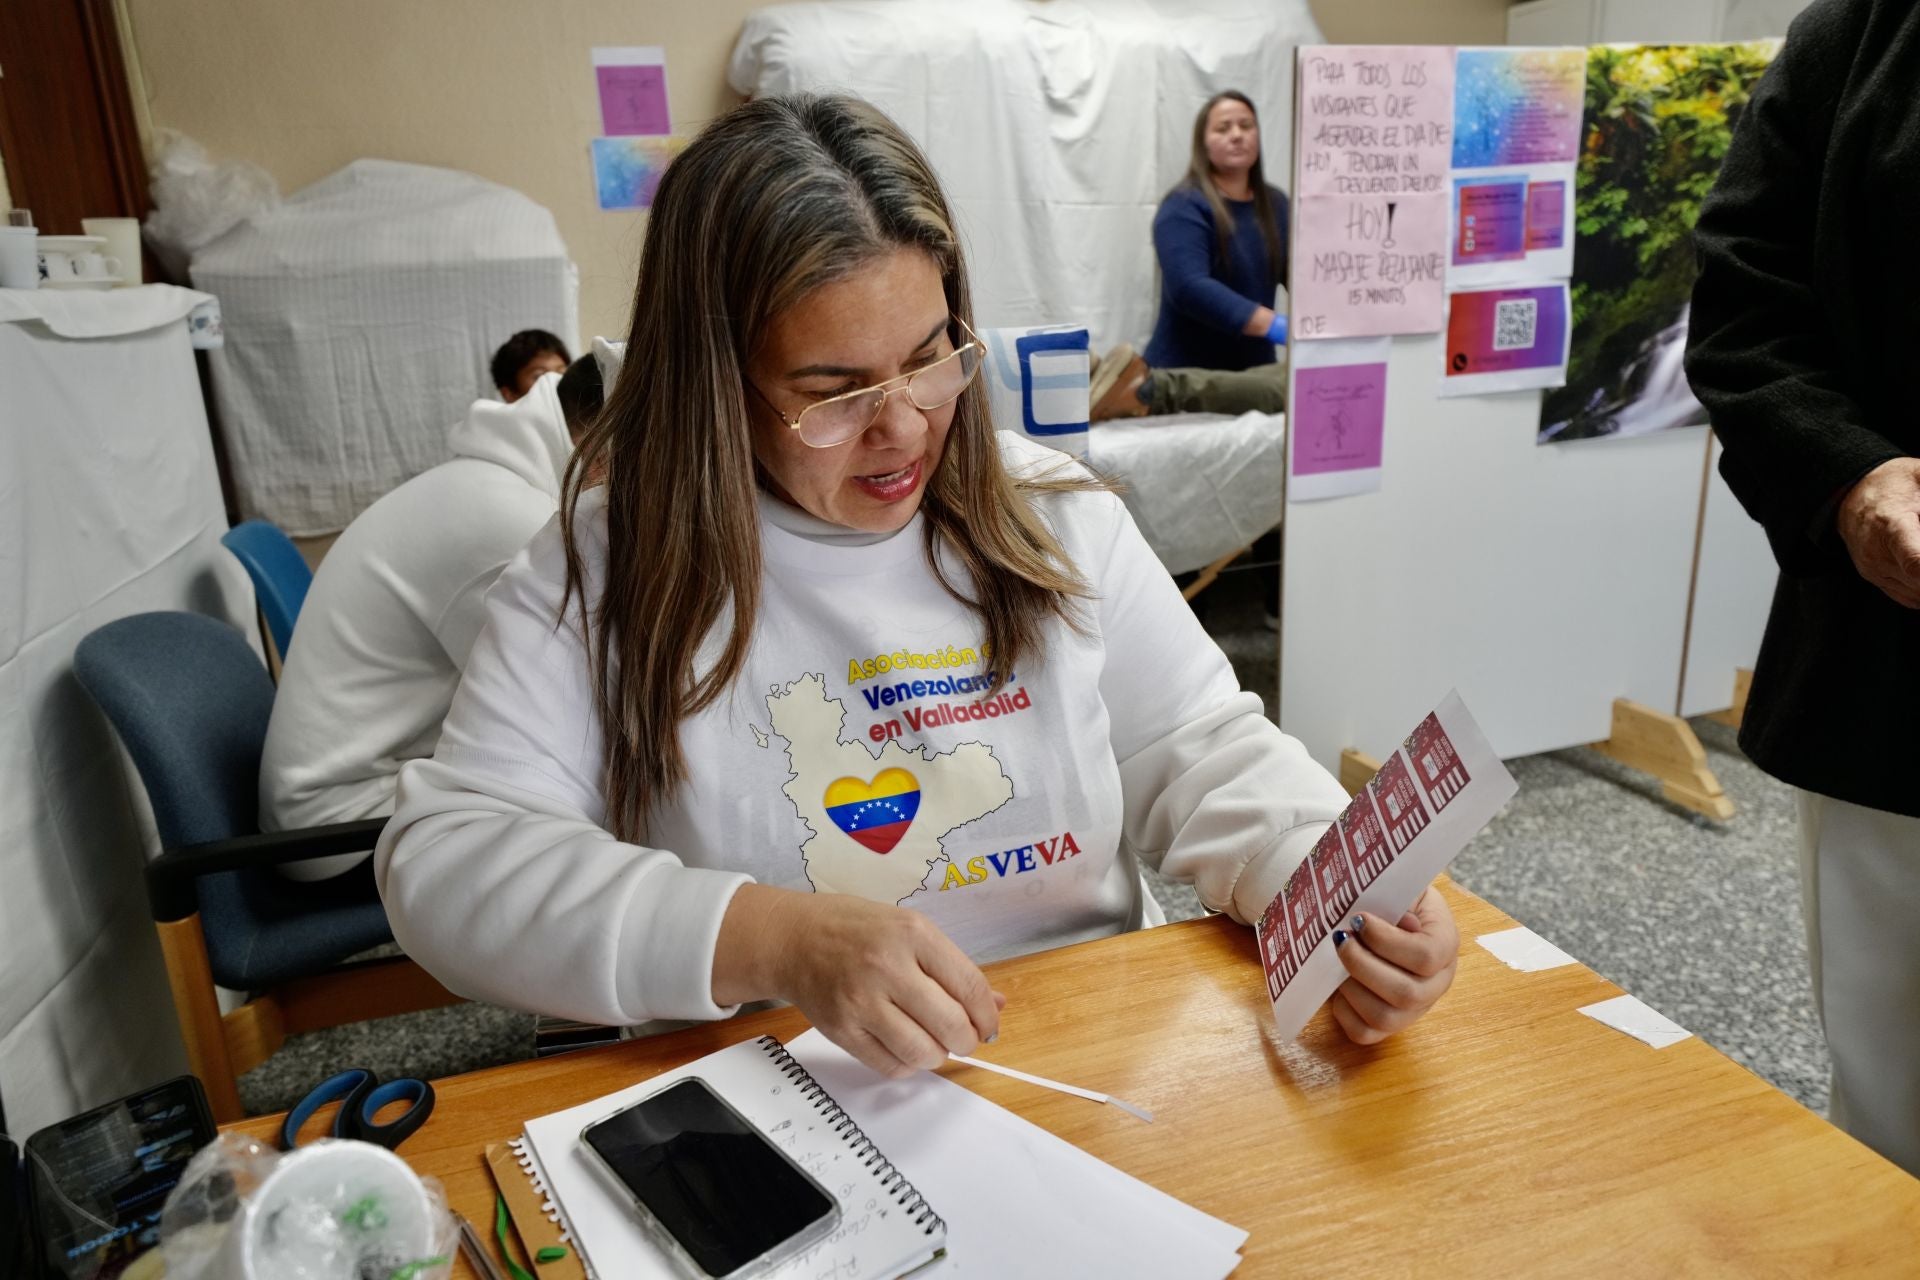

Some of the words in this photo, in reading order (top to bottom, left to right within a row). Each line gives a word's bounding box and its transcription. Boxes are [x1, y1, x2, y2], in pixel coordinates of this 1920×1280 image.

[1353, 61, 1391, 88] TODOS
[1402, 61, 1427, 87] LOS
[1385, 94, 1416, 119] QUE
[1383, 126, 1401, 148] EL
[1428, 121, 1451, 146] DE
[1345, 202, 1397, 248] HOY!
[1312, 251, 1373, 284] MASAJE
[1378, 250, 1446, 285] RELAJANTE
[1348, 289, 1362, 305] 15
[848, 645, 977, 685] Asociación
[869, 719, 903, 742] en
[903, 687, 1032, 732] Valladolid
[939, 832, 1082, 891] ASVEVA
